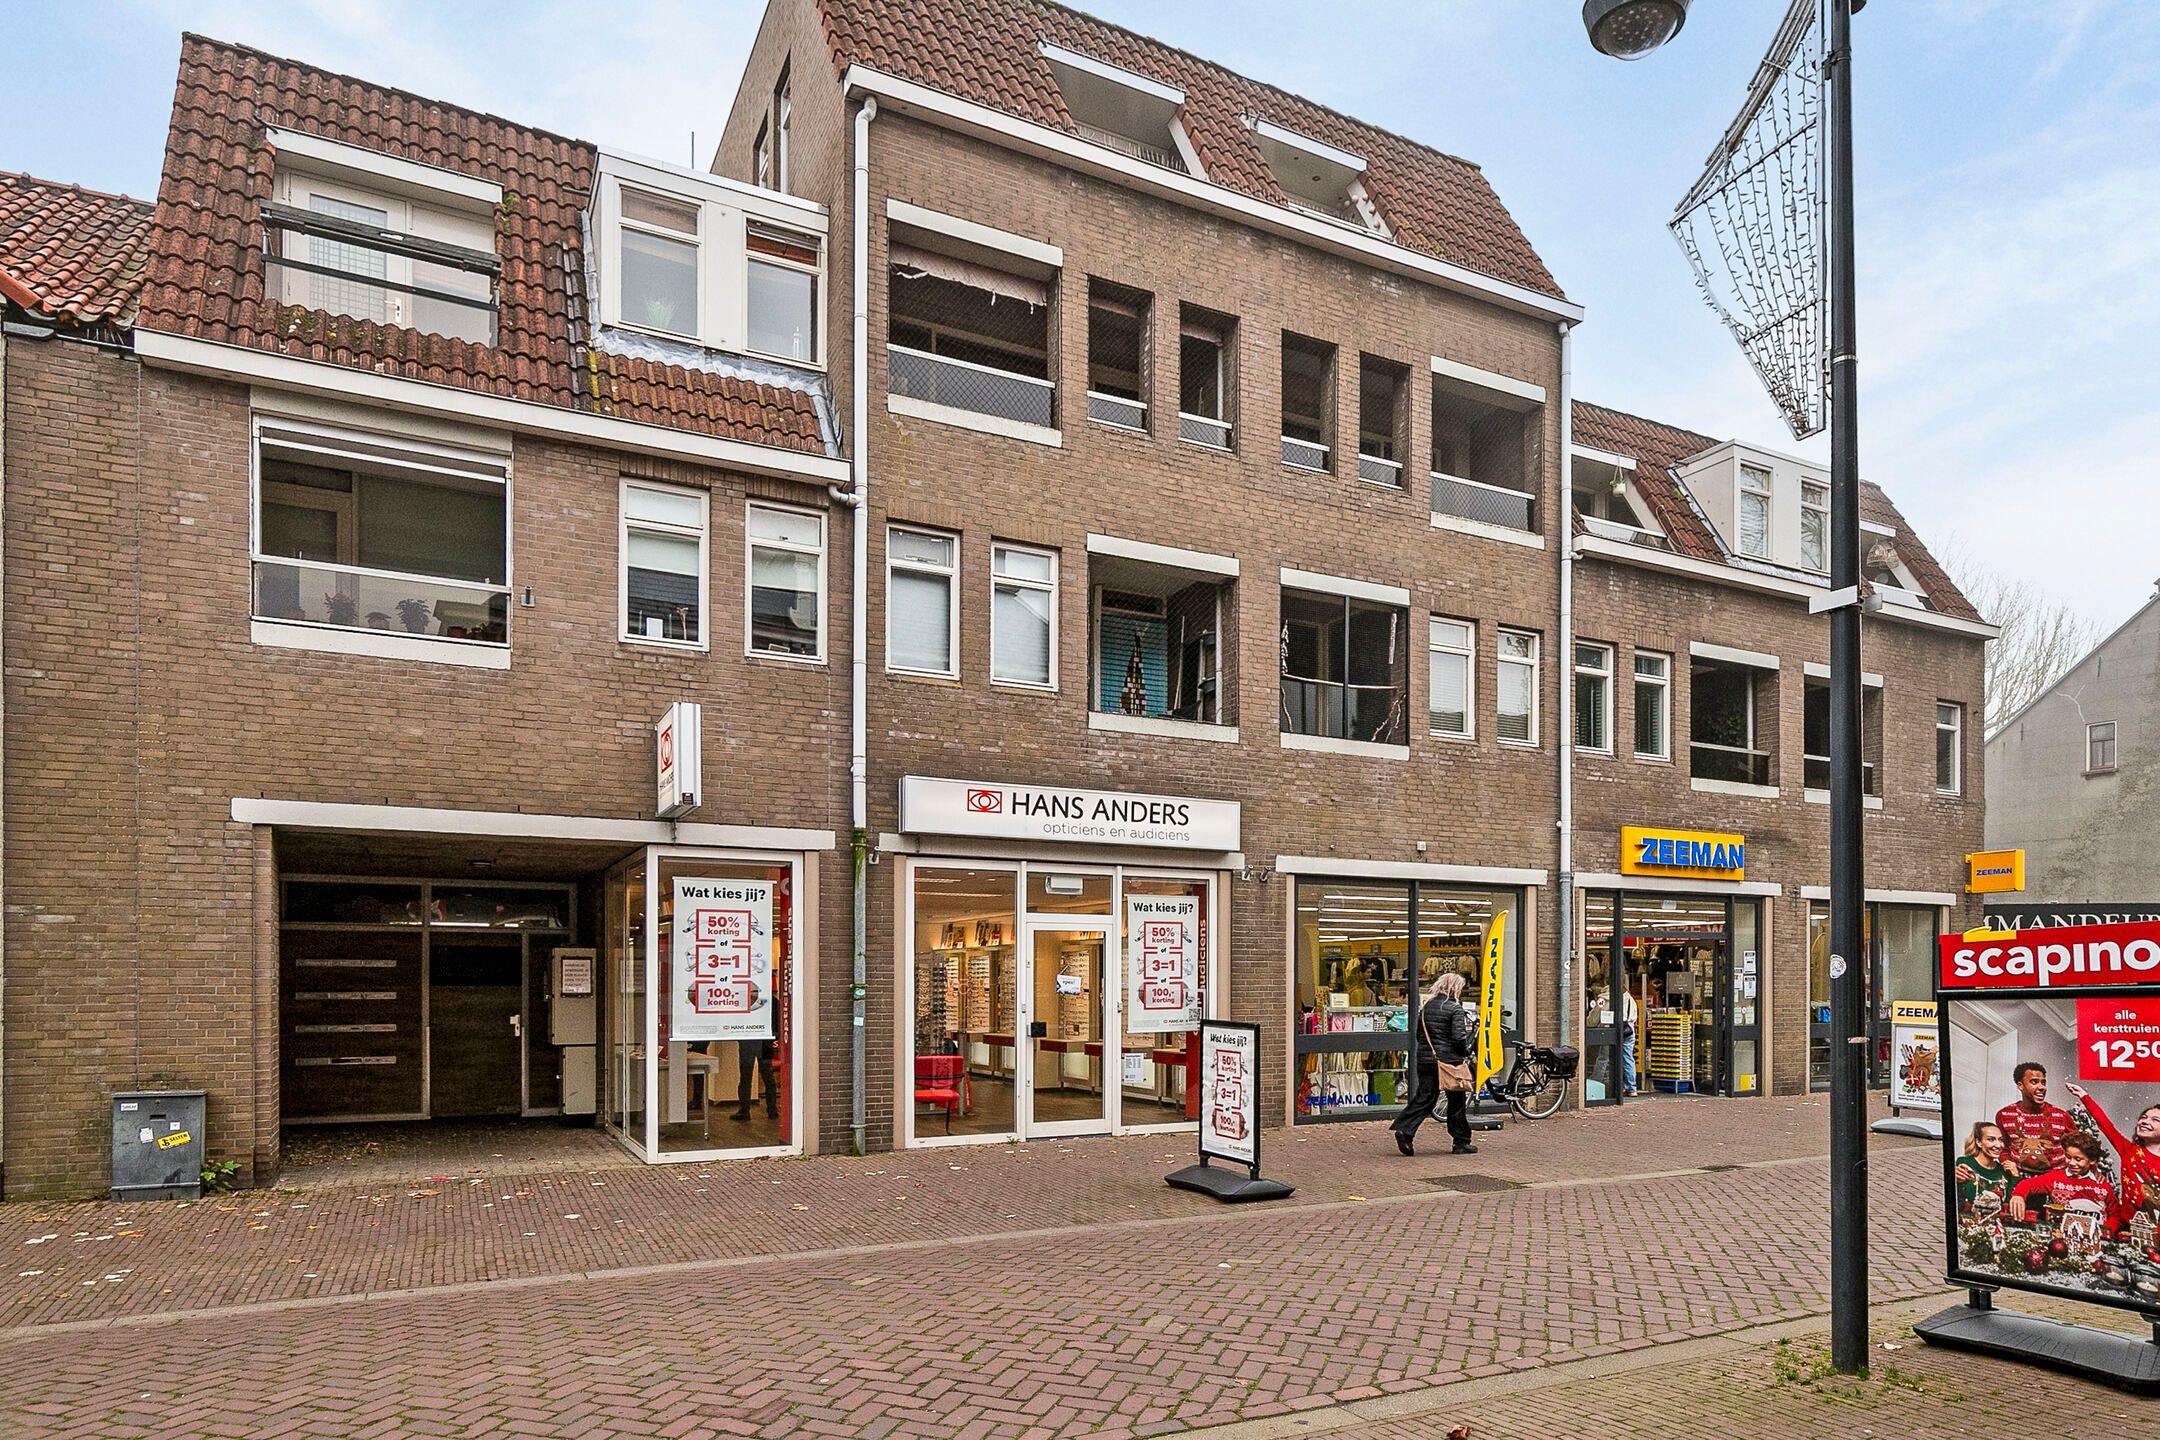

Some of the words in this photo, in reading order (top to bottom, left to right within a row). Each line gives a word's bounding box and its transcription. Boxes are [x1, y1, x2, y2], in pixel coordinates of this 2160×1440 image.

[1012, 792, 1084, 819] HANS
[1091, 798, 1190, 826] ANDERS
[1043, 822, 1105, 837] opticiens
[1109, 826, 1126, 838] en
[1130, 829, 1190, 842] audiciens
[1640, 837, 1744, 869] ZEEMAN
[1976, 867, 2013, 876] ZEEMAN
[682, 886, 709, 898] Wat
[714, 887, 742, 899] kies
[745, 888, 766, 902] jij?
[1133, 903, 1153, 912] Wat
[1155, 903, 1176, 912] kies
[1178, 903, 1194, 915] jij?
[708, 916, 740, 928] 50%
[708, 928, 740, 937] korting
[1152, 927, 1175, 937] 50%
[1199, 919, 1207, 989] udiciens
[708, 955, 740, 968] 3=1
[1152, 960, 1175, 971] 3=1
[1954, 939, 2160, 986] scapino
[707, 988, 740, 999] 100,-
[1152, 988, 1175, 997] 100,-
[707, 998, 740, 1007] korting
[2115, 1010, 2137, 1020] alle
[2094, 1023, 2160, 1033] kersttruien
[1210, 1033, 1222, 1043] Wat
[1223, 1034, 1236, 1045] kies
[1221, 1088, 1236, 1101] 3=1
[1305, 1094, 1381, 1107] ZEEMAN.COM
